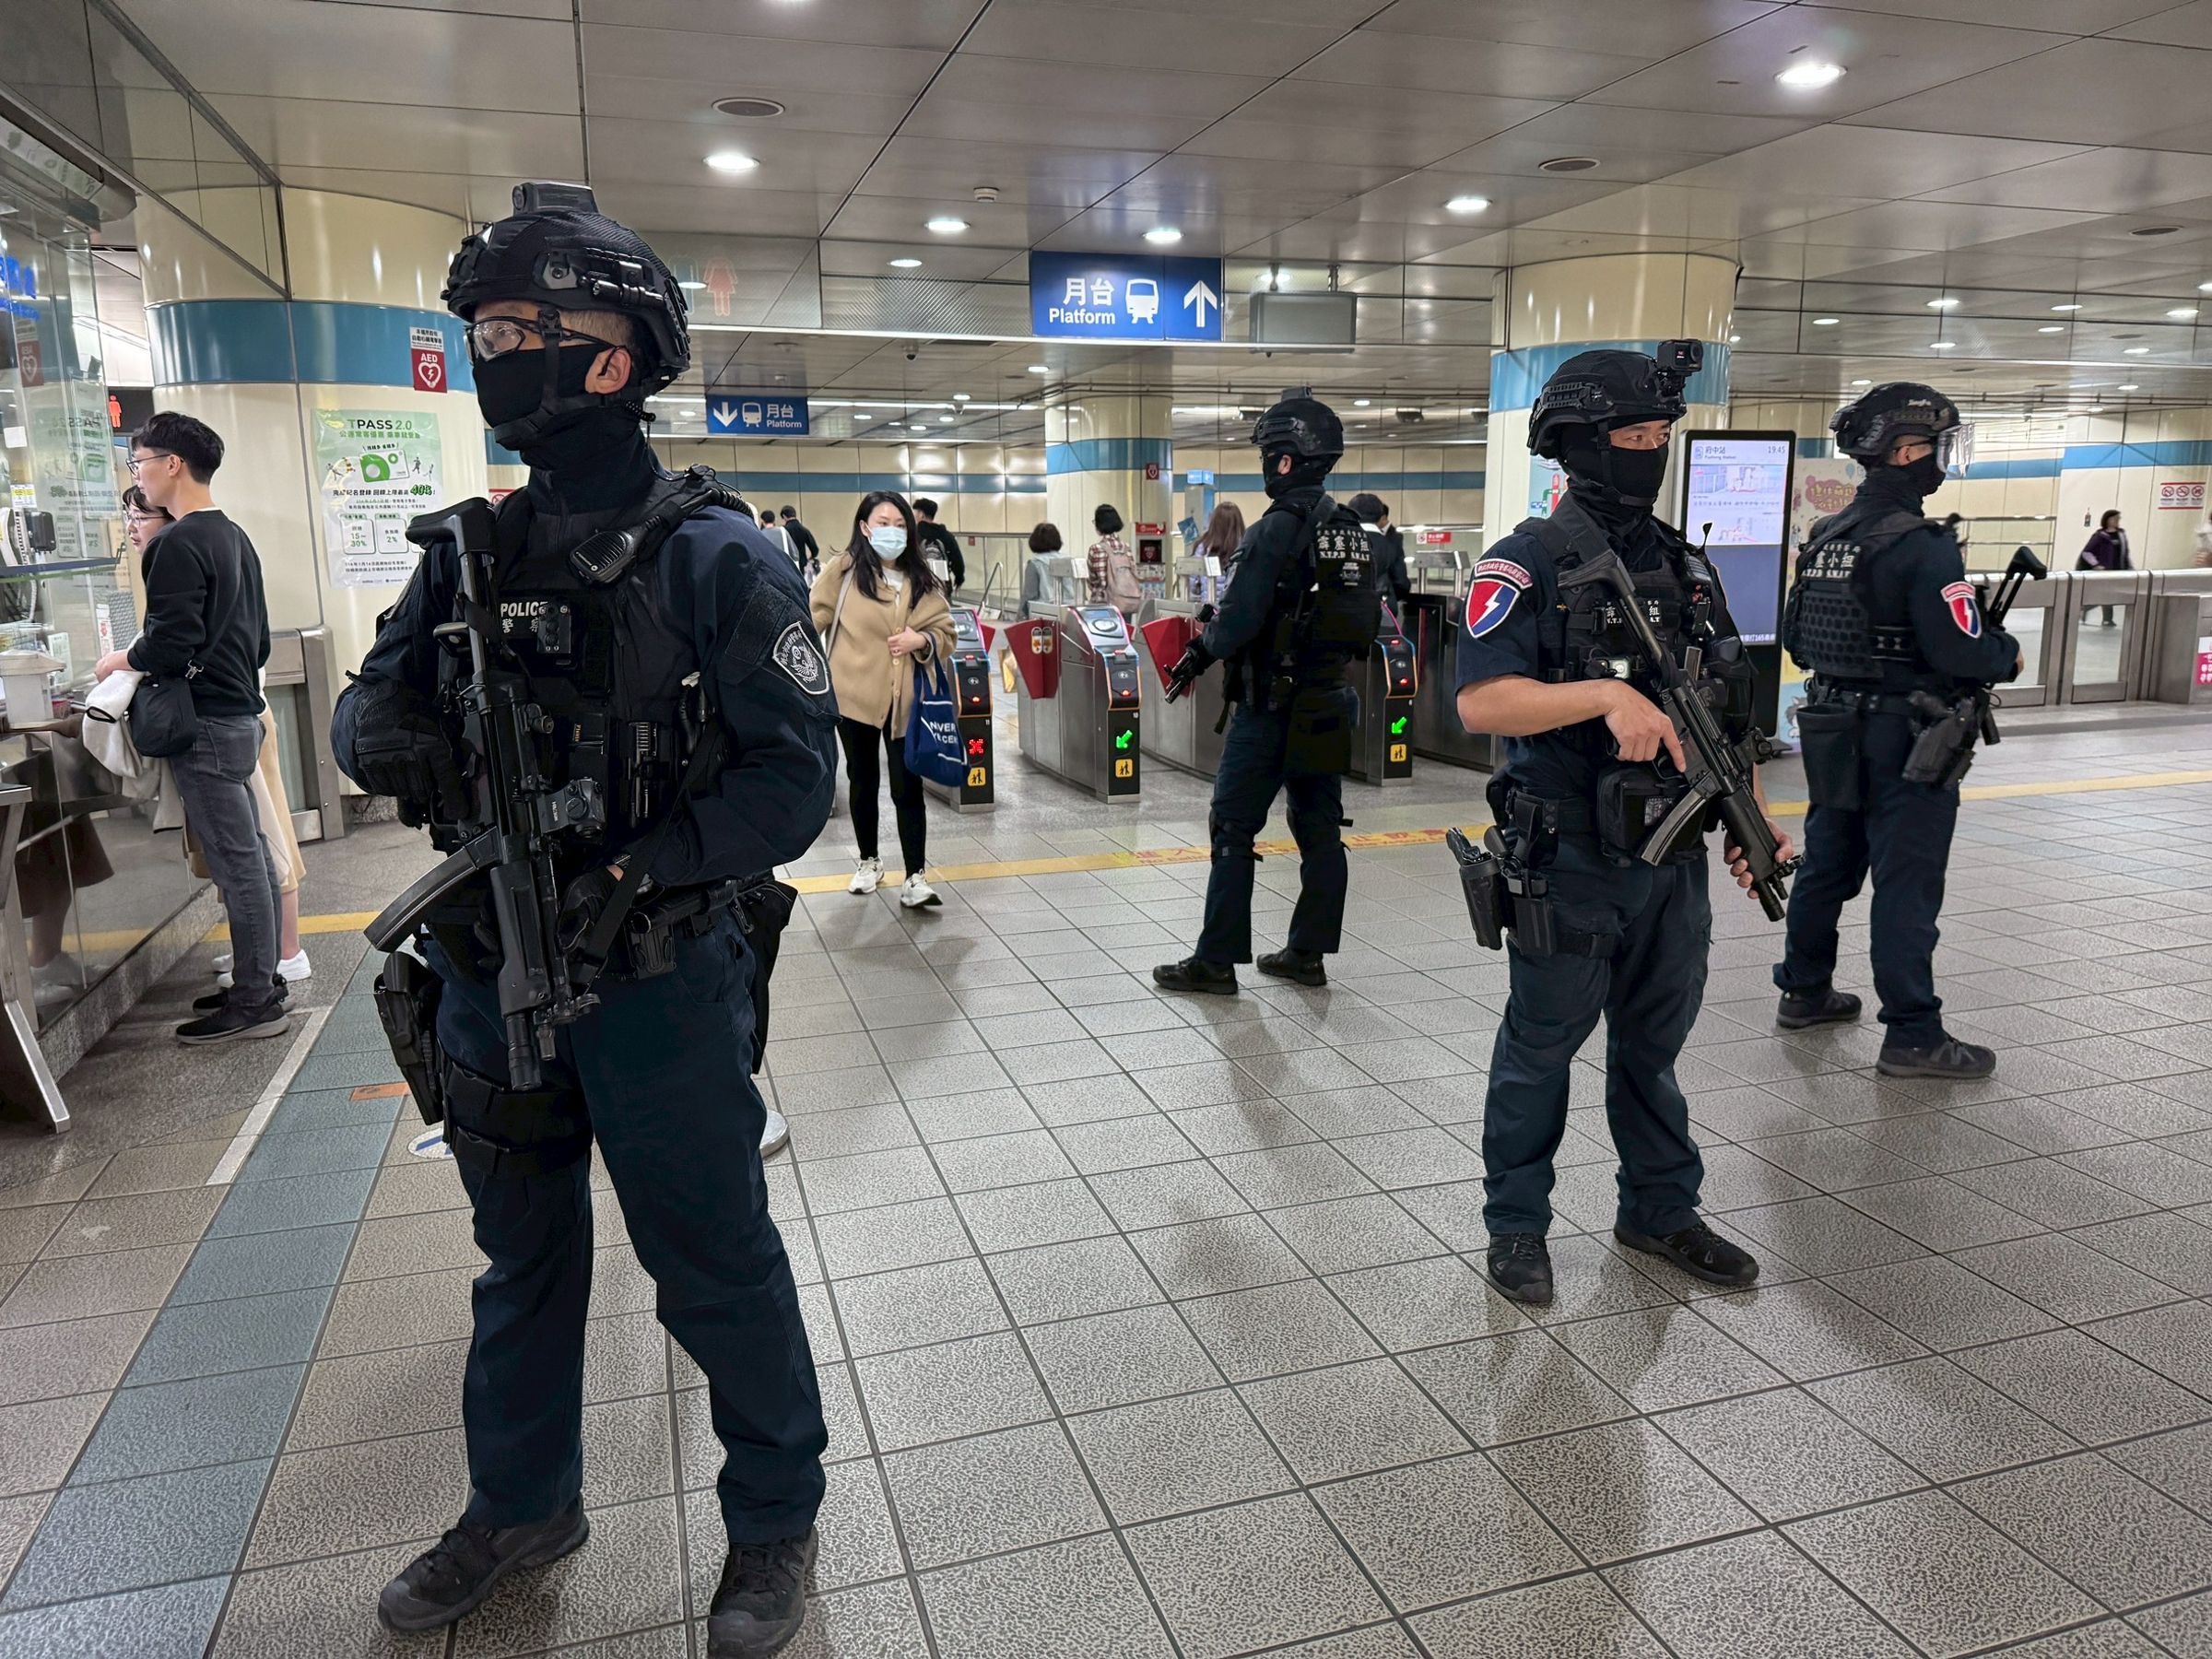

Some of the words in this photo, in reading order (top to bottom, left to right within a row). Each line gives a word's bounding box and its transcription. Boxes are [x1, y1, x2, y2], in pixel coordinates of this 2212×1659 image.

[1063, 277, 1115, 306] 月台
[1049, 307, 1116, 325] Platform
[420, 352, 439, 363] AED
[767, 404, 794, 418] 月台
[347, 418, 394, 430] TPASS
[394, 419, 413, 430] 2.0
[766, 419, 803, 429] Platform
[1811, 550, 1854, 568] 靂小組
[500, 601, 548, 618] POLIC
